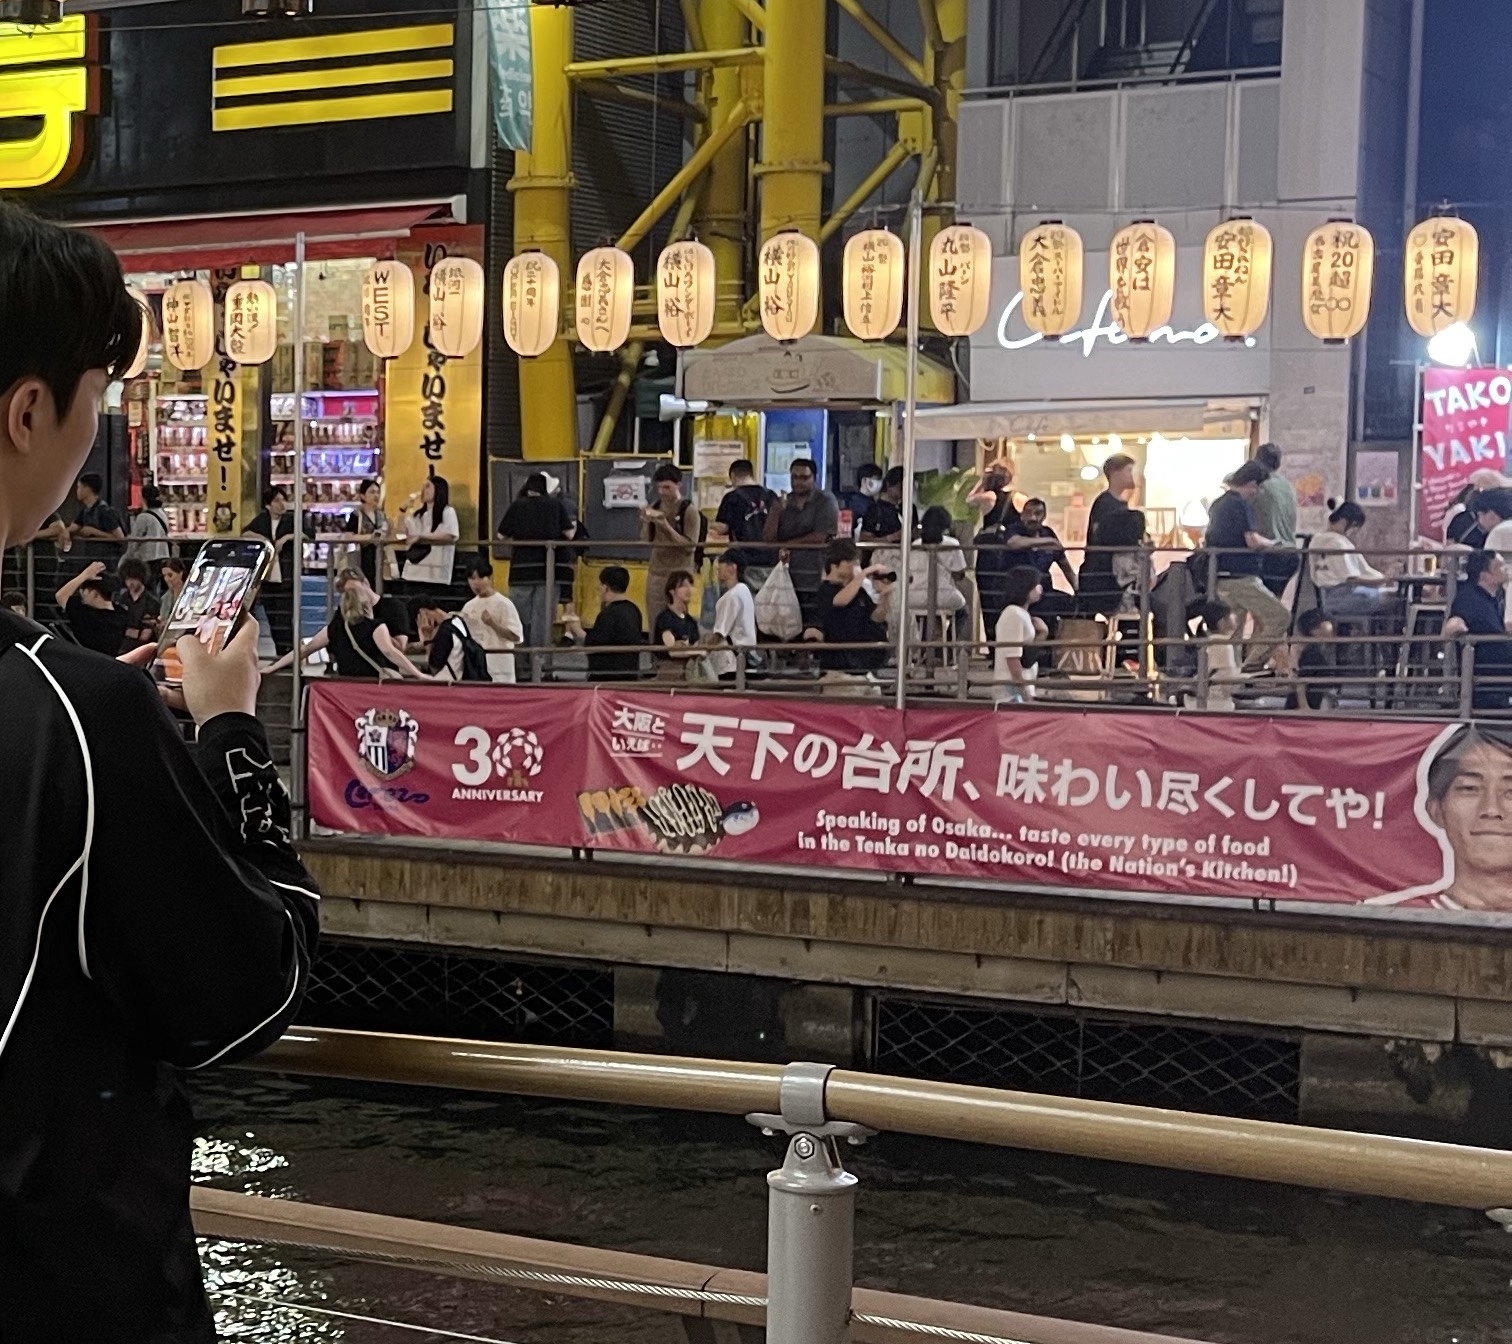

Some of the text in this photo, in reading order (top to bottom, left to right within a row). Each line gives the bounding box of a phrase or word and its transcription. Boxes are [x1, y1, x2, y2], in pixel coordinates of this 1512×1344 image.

[1212, 231, 1237, 322] 安田章大
[374, 270, 390, 337] WEST
[1423, 375, 1512, 418] TAKO
[1422, 430, 1507, 471] YAKI
[612, 707, 666, 735] 大阪と
[451, 787, 544, 803] ANNIVERSARY
[816, 809, 900, 836] Speaking
[906, 813, 927, 833] of
[1019, 825, 1071, 845] taste
[1077, 832, 1135, 854] every
[1142, 833, 1189, 856] type
[1194, 833, 1217, 853] of
[1221, 834, 1270, 856] food
[798, 831, 816, 849] in
[821, 833, 850, 852] the
[855, 835, 910, 856] Tenka
[914, 842, 940, 857] no
[1061, 850, 1103, 874] (the
[1201, 859, 1298, 889] Kitchen!)
